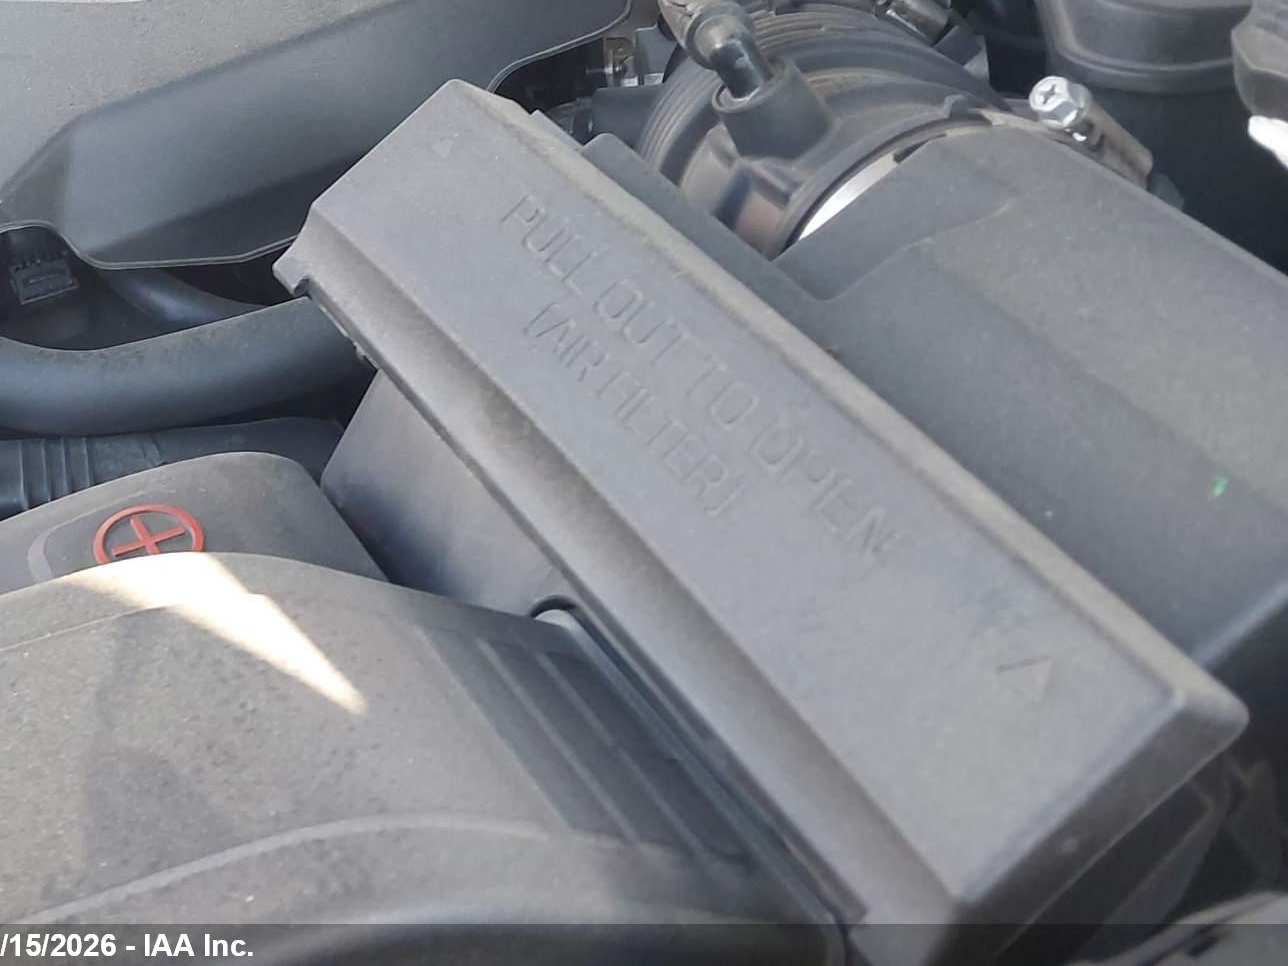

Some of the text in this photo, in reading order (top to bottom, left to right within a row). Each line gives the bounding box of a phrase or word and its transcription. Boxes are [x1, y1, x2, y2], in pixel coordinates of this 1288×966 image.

[499, 193, 909, 564] PULL OUT TO OPEN
